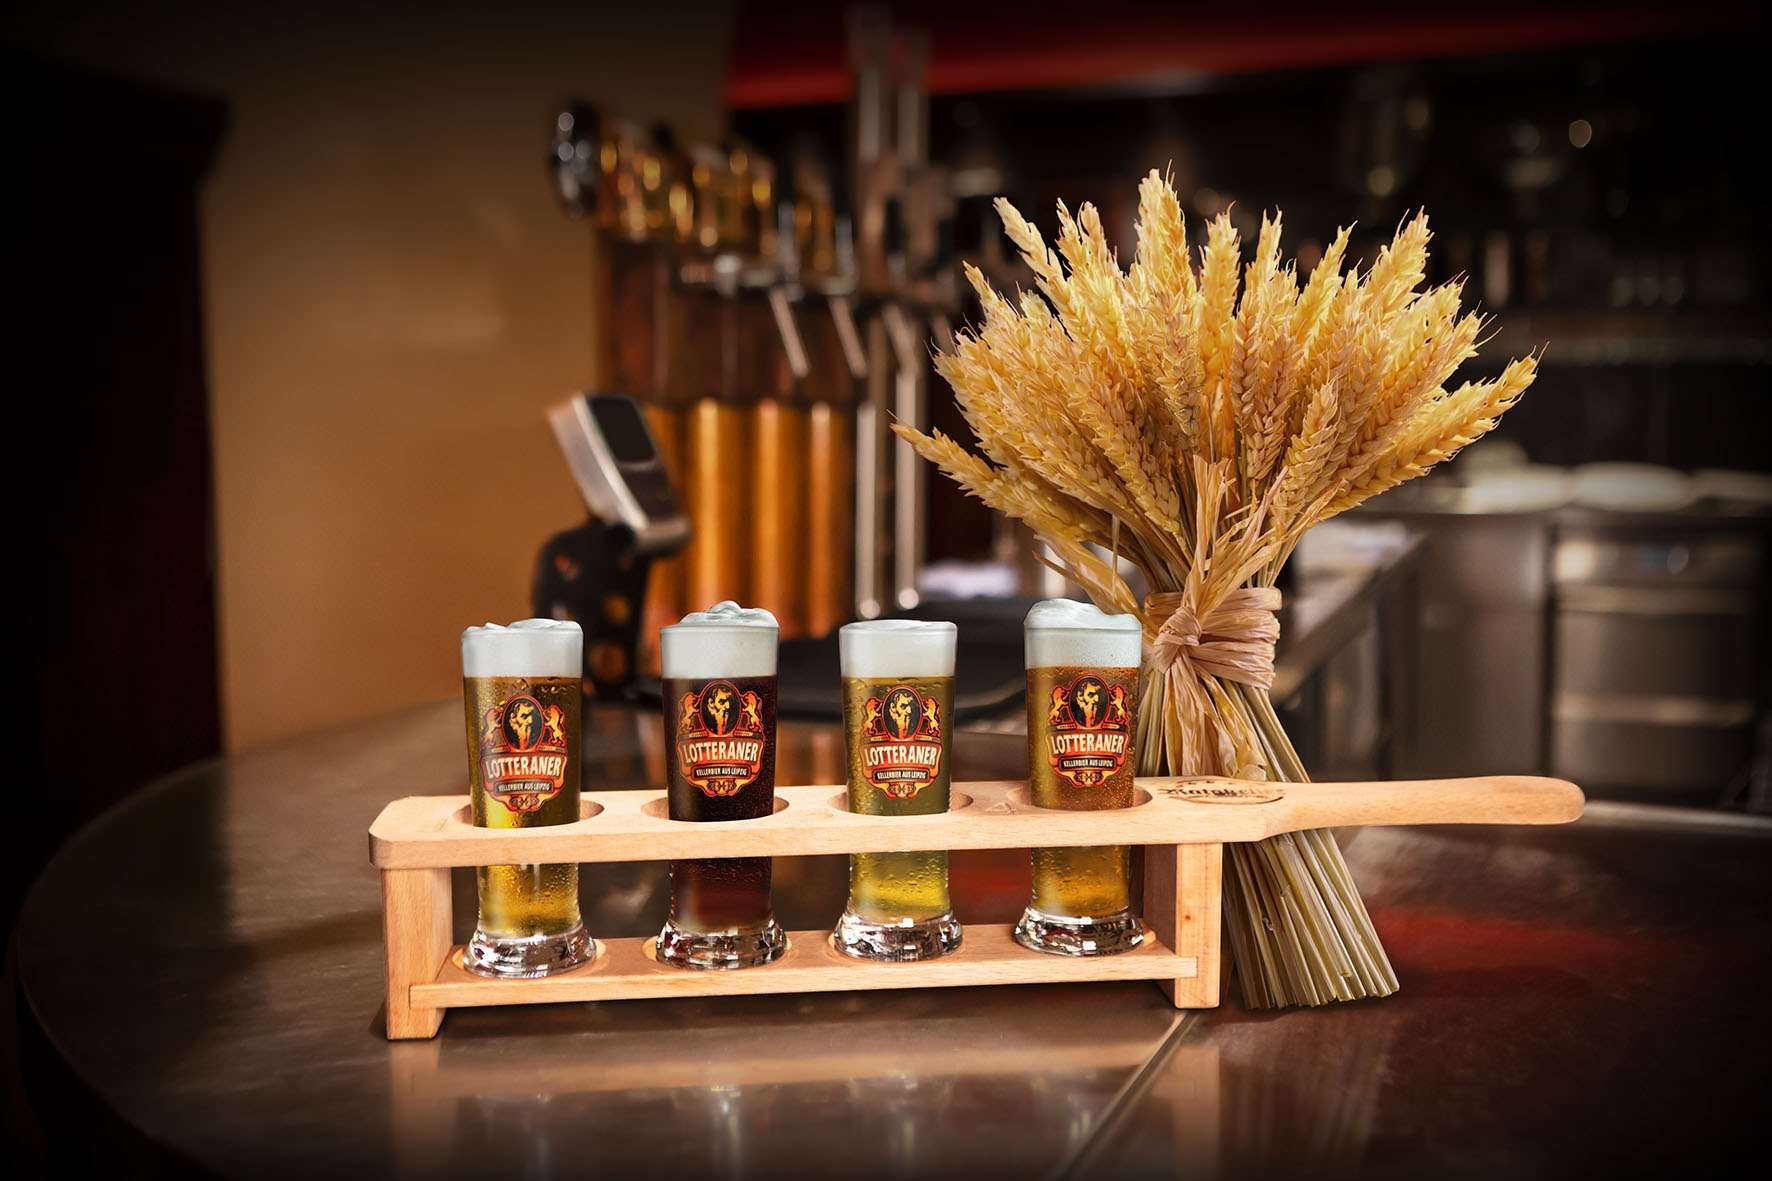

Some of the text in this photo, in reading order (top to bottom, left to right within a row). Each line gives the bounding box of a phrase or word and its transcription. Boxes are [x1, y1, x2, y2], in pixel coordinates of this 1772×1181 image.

[683, 741, 759, 763] LOTTERANER
[1050, 733, 1124, 754] LOTTERANER
[864, 745, 937, 767] LOTTERANER
[1063, 759, 1088, 767] KELLERBIER
[485, 756, 562, 779] LOTTERANER
[696, 767, 721, 776] KELLERBIER
[721, 767, 731, 775] AUS
[876, 771, 901, 780] KELLERBIER
